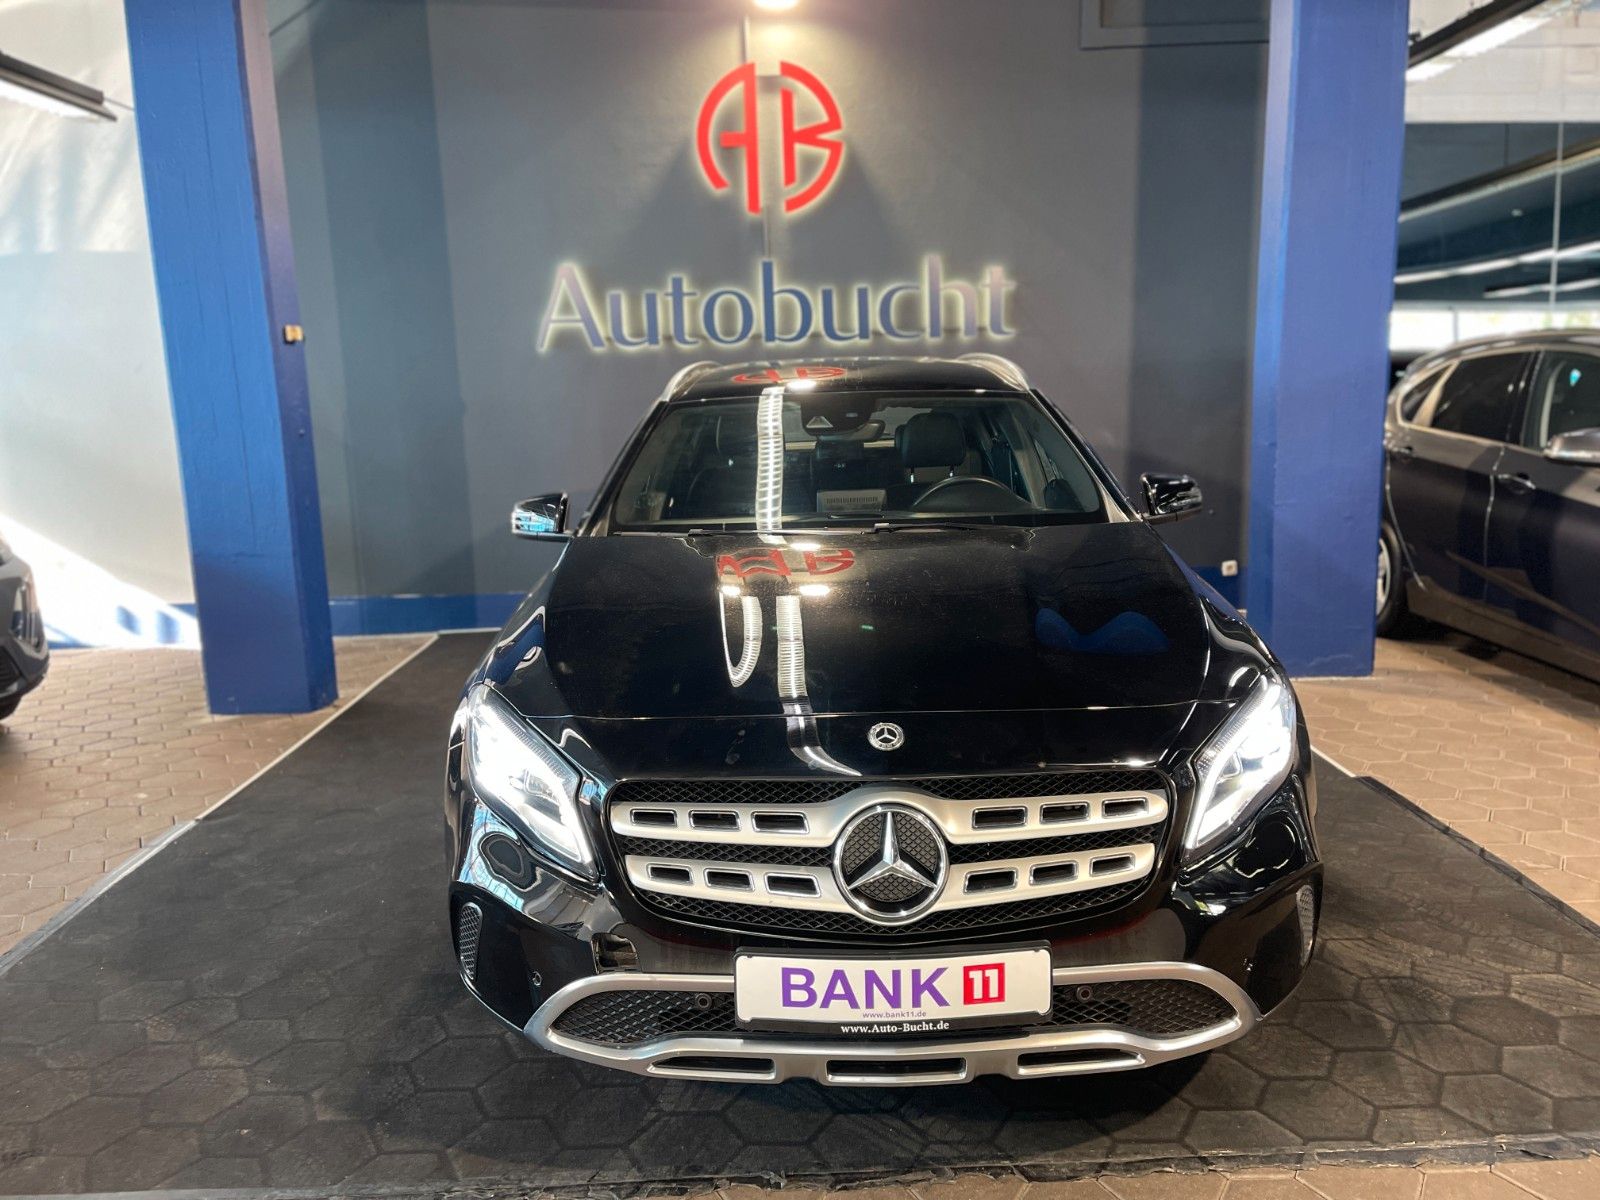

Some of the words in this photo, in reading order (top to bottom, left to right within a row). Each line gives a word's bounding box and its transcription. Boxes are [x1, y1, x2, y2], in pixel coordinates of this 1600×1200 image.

[696, 60, 844, 214] AB
[537, 255, 1016, 352] Autobucht
[780, 966, 951, 1010] BANK
[967, 966, 1001, 1001] 11
[840, 1020, 950, 1033] www.Auto-Bucht.de
[862, 1010, 927, 1019] www.bank11.de
